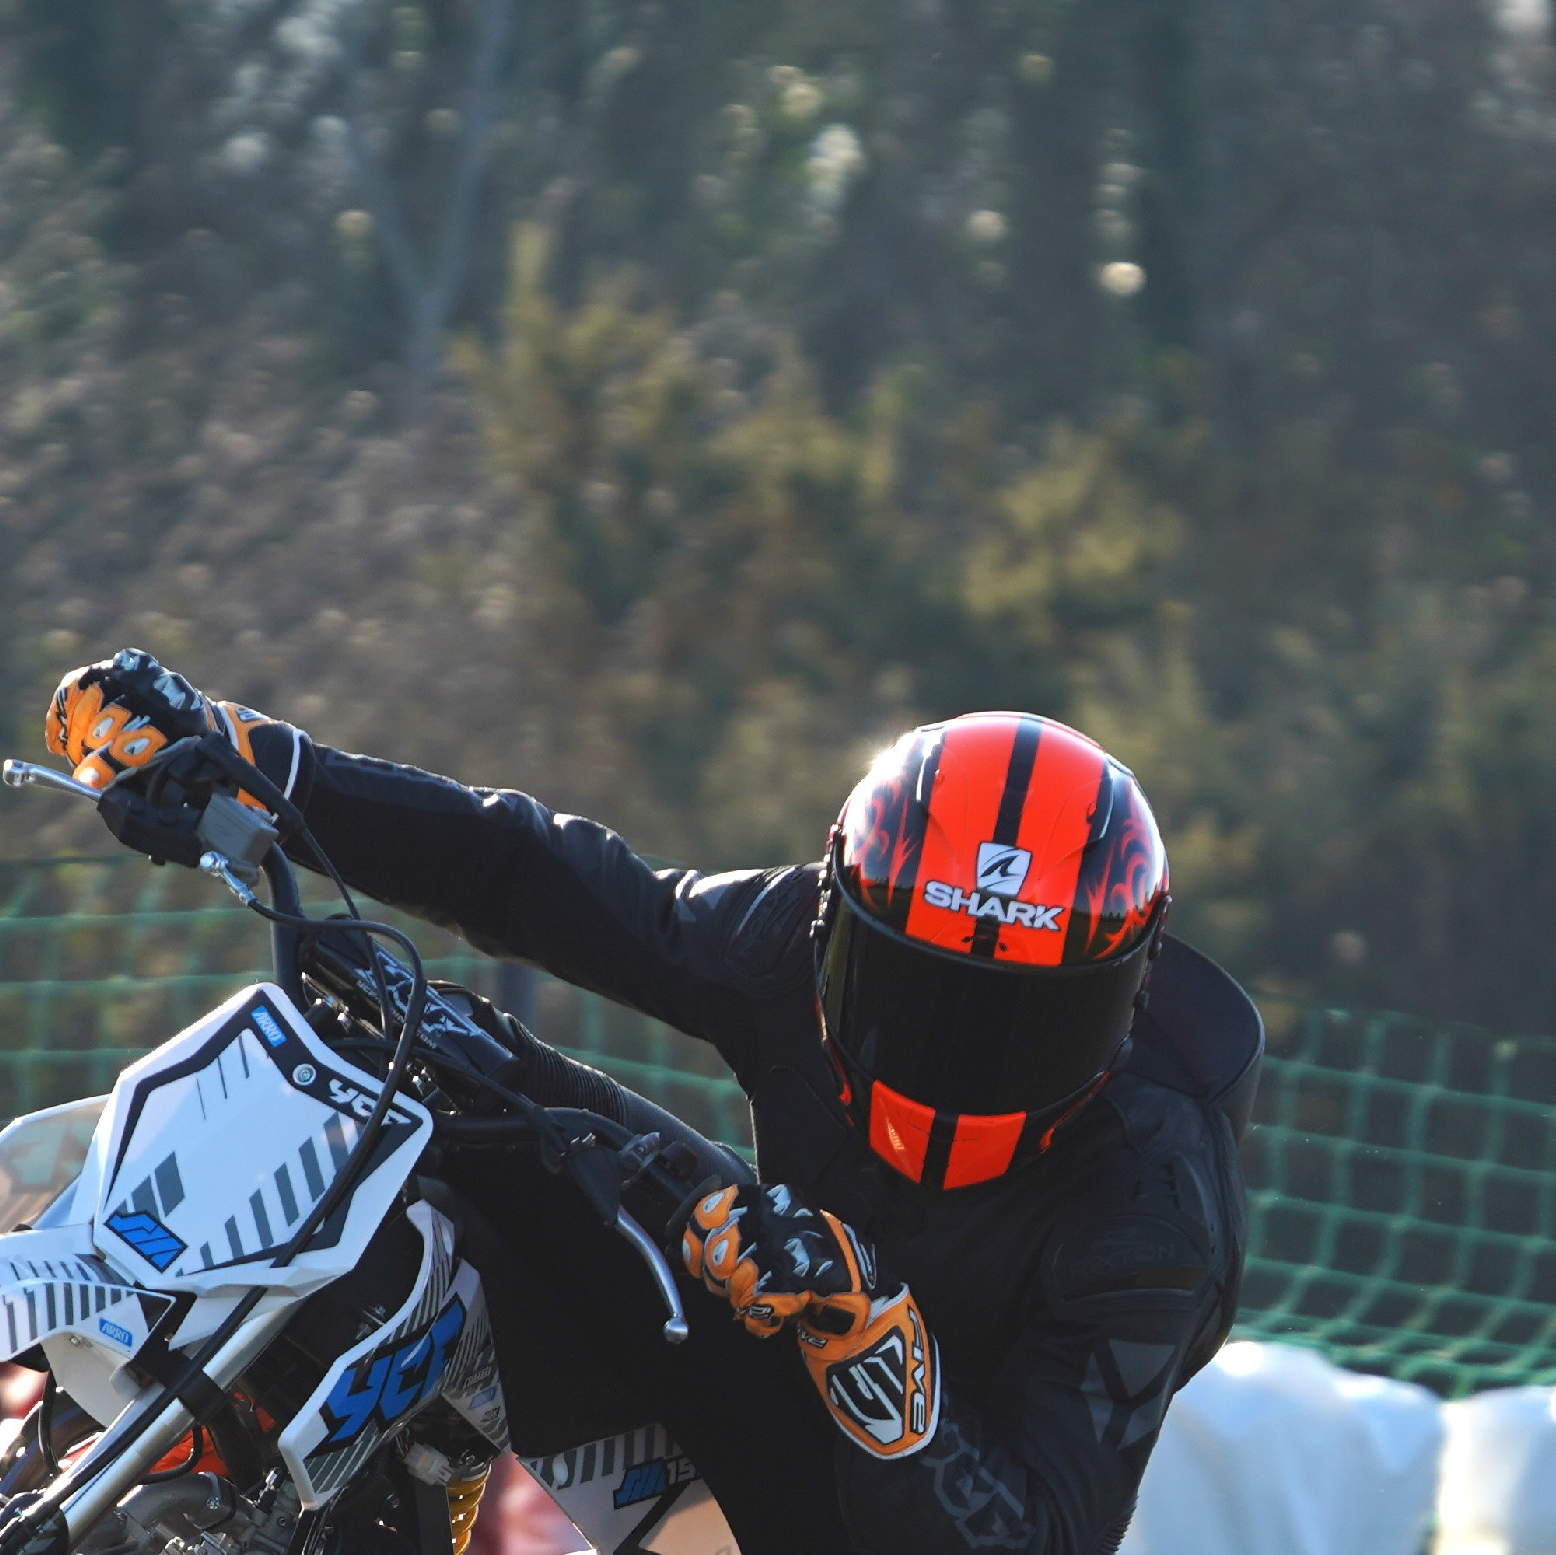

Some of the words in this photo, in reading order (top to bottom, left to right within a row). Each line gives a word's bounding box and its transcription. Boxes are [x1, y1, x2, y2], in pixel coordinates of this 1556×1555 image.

[924, 880, 1065, 930] SHARK
[324, 1301, 465, 1443] YCF
[908, 1307, 926, 1435] FIVE
